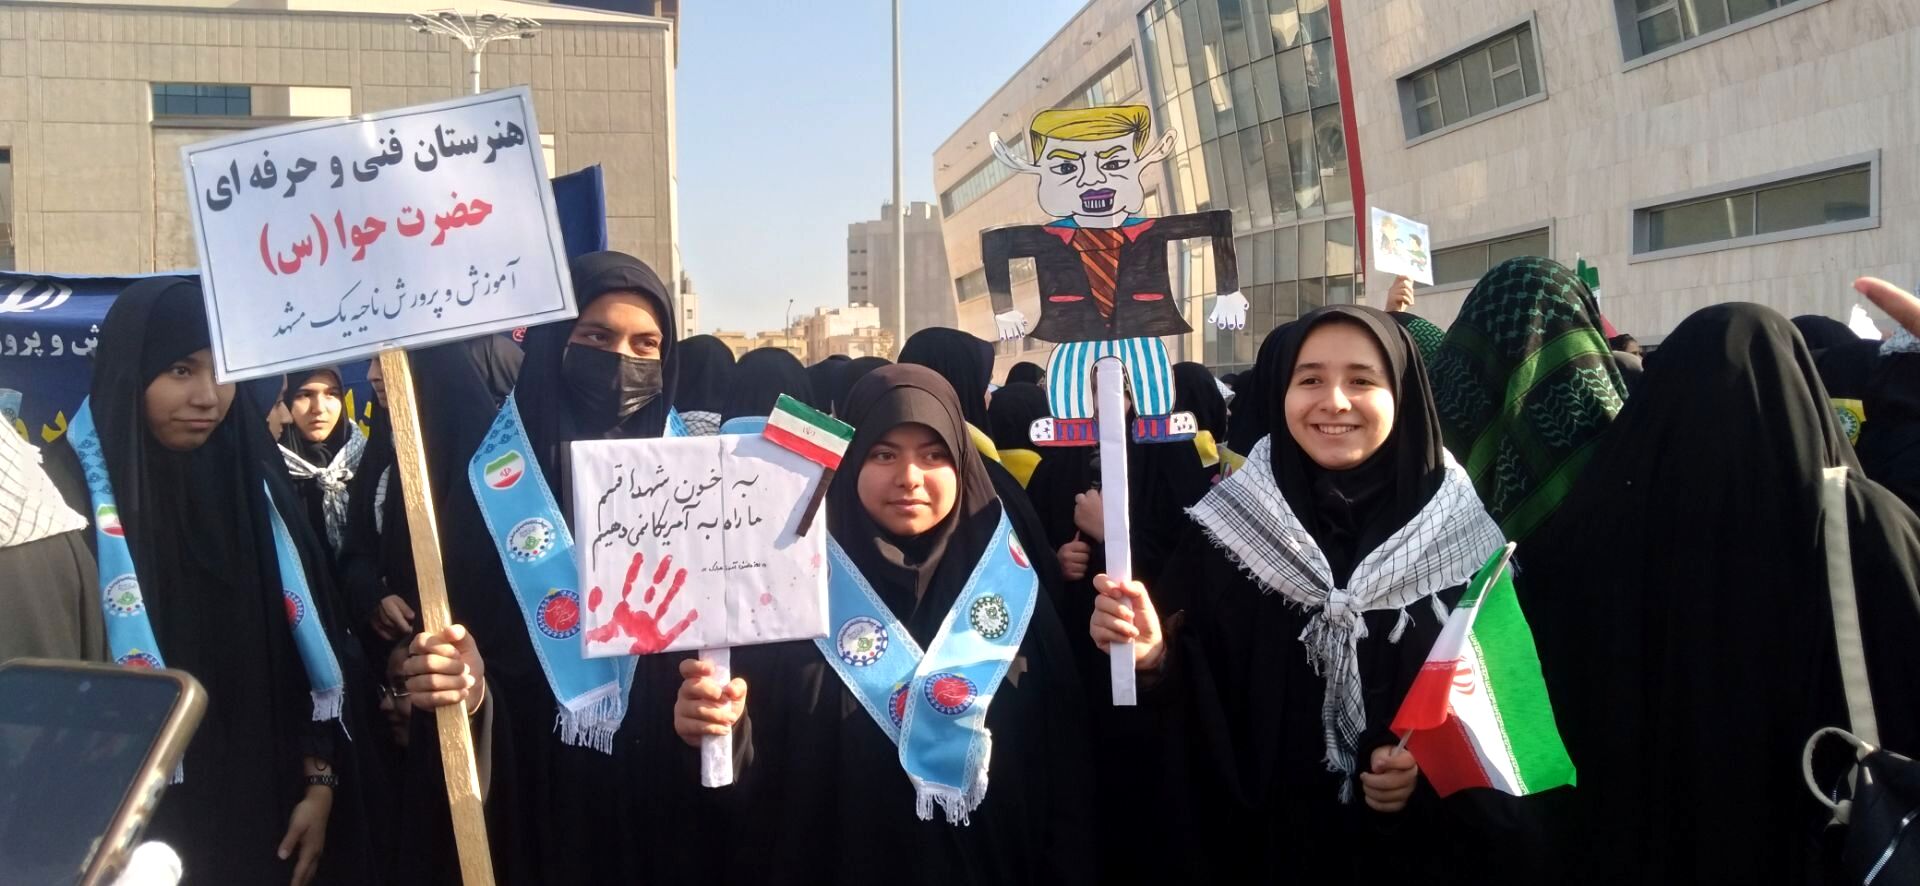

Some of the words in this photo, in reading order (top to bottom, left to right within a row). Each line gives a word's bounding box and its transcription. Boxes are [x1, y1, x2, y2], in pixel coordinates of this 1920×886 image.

[352, 128, 403, 182] فنی
[414, 120, 525, 172] هنرستان
[206, 160, 241, 212] ای
[249, 149, 318, 198] حرفه
[330, 155, 344, 189] و
[334, 211, 387, 261] حوا
[396, 191, 494, 246] حضرت
[259, 213, 329, 276] (س)
[383, 276, 446, 319] پرورش
[445, 287, 453, 302] و
[456, 256, 521, 308] آموزش
[273, 301, 306, 338] مشهد
[310, 280, 362, 338] یک
[350, 287, 381, 333] ناحیه
[598, 463, 623, 532] قسم
[629, 464, 669, 499] شهدا
[673, 468, 722, 504] خون
[732, 474, 759, 499] به
[652, 498, 701, 546] آمریکا
[696, 517, 719, 540] به
[748, 505, 763, 526] ما
